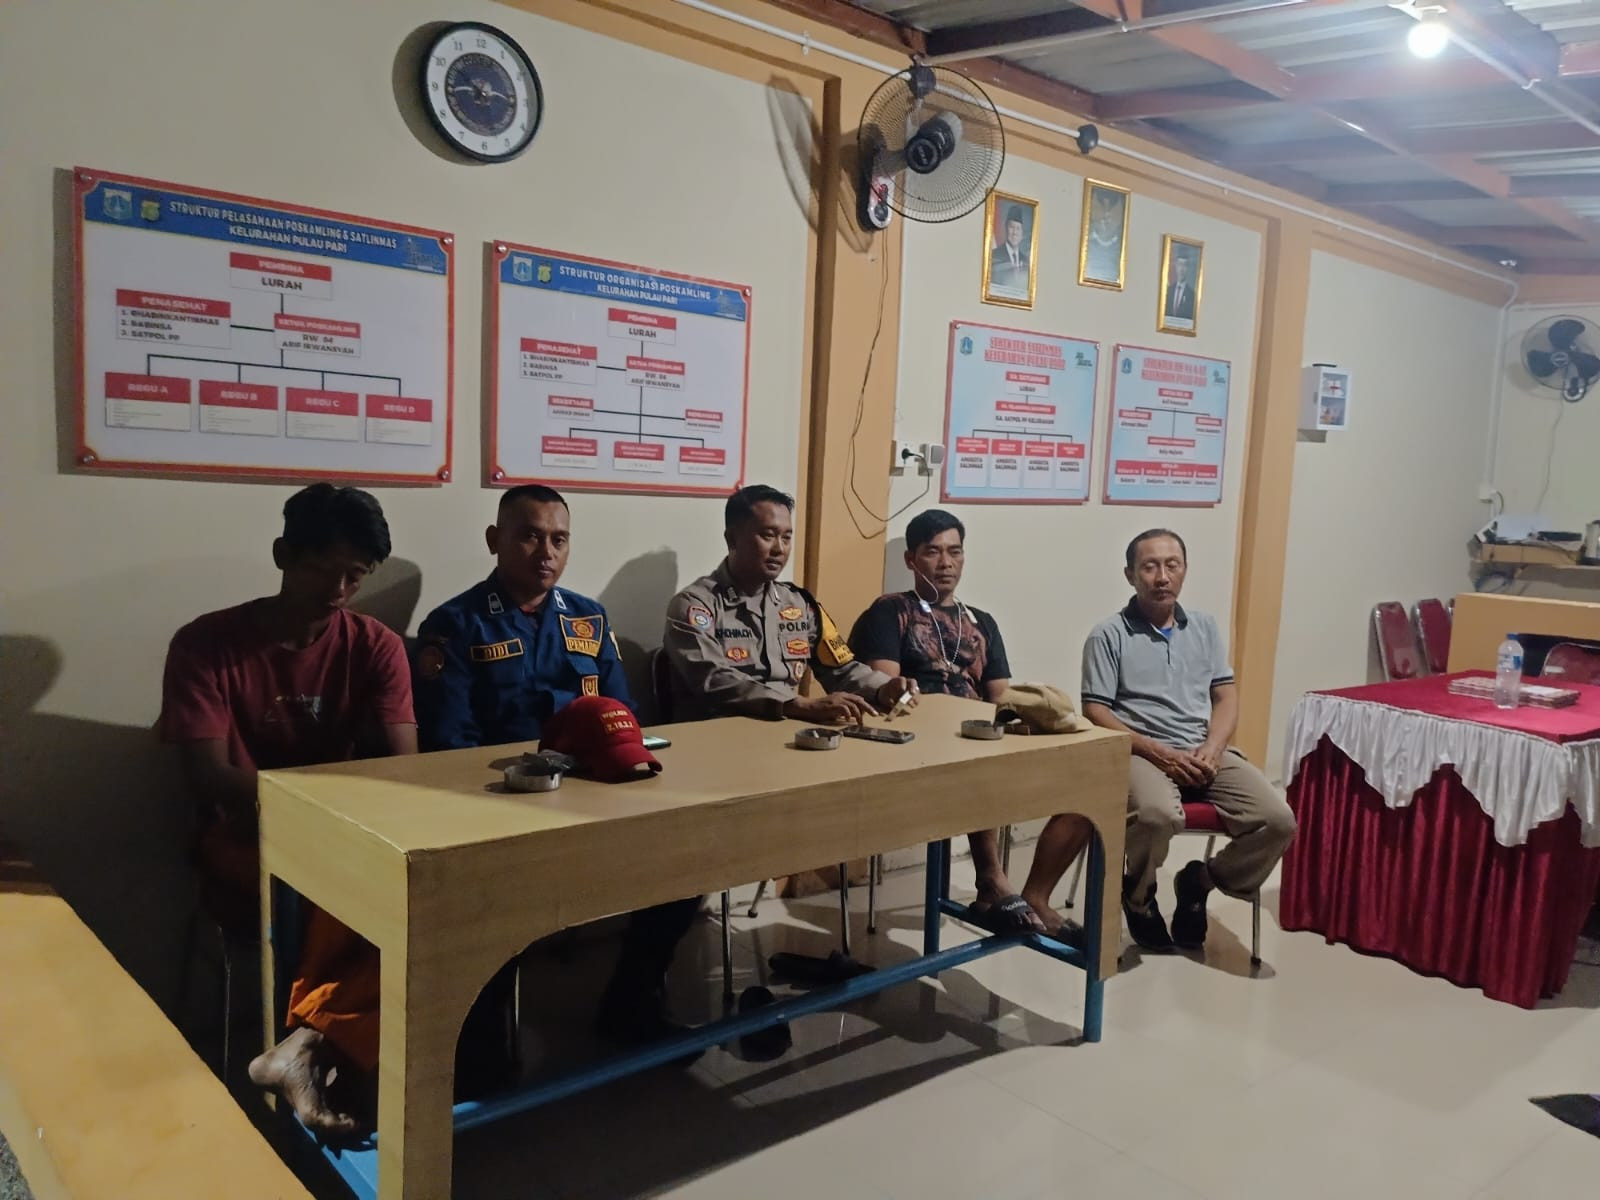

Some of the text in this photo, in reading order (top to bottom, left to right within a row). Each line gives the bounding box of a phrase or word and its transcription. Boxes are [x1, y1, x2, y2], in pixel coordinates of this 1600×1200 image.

[169, 201, 220, 219] STRUKTUR
[285, 220, 342, 240] POSKAMLING
[350, 231, 397, 249] SATLINMAS
[229, 226, 347, 254] KELURAHAN PULAU PARI
[261, 277, 303, 291] LURAH
[559, 265, 711, 300] STRUKTUR ORGANISASI POSKAMLING
[597, 284, 639, 299] KELURAHAN
[639, 292, 662, 303] PULAU
[628, 327, 657, 338] LURAH
[128, 383, 158, 393] REGU
